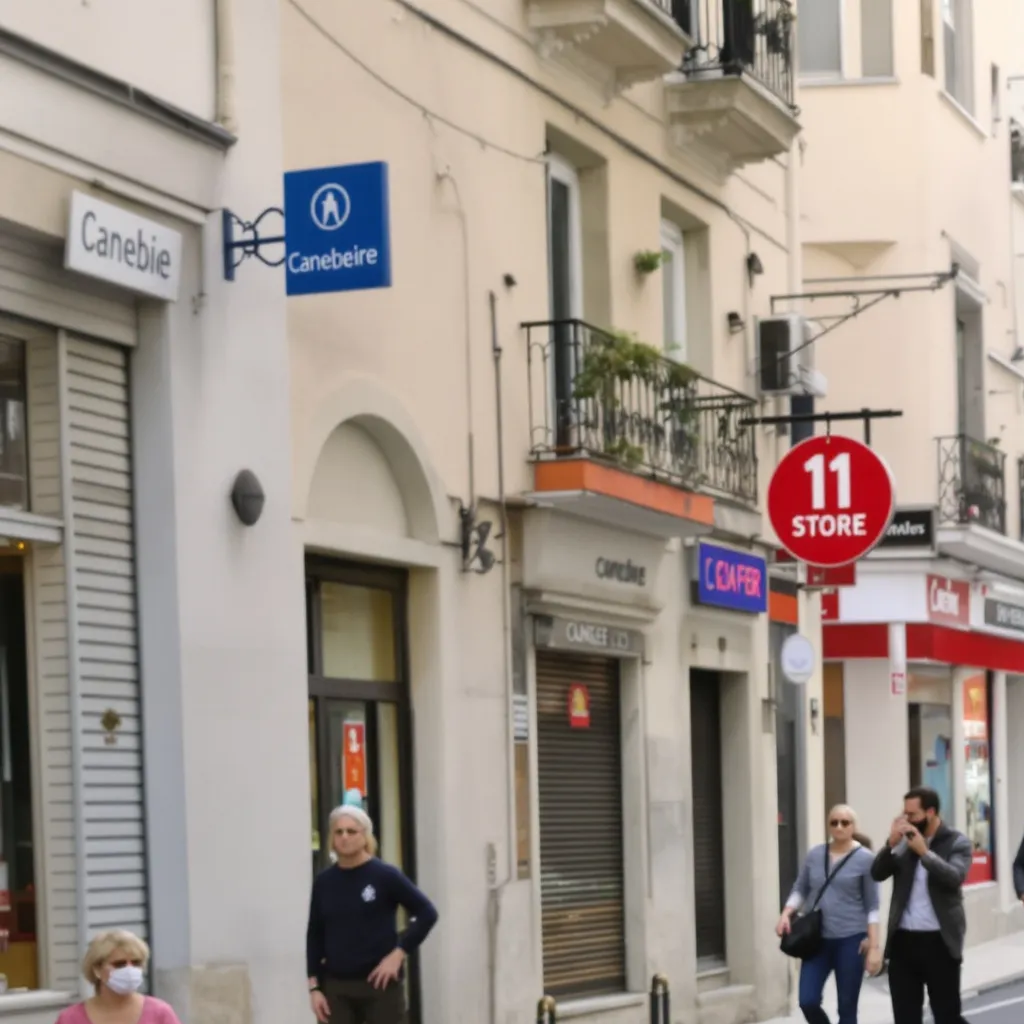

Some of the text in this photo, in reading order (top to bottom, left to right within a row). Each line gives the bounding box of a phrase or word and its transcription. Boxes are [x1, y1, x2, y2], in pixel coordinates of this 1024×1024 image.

[81, 211, 171, 280] Canebie
[288, 245, 378, 274] Canebeire
[804, 453, 851, 509] 11
[792, 513, 867, 537] STORE
